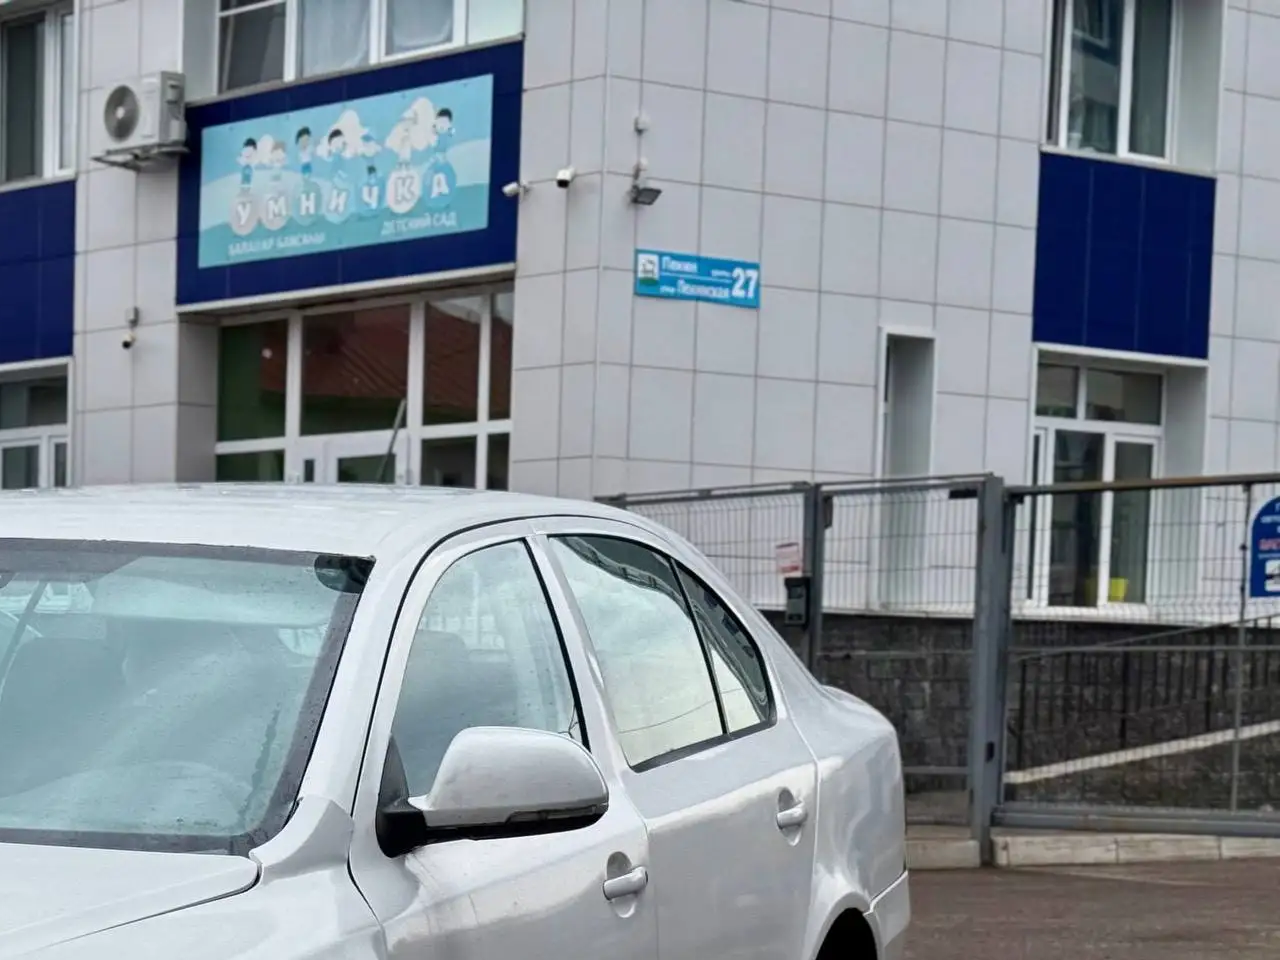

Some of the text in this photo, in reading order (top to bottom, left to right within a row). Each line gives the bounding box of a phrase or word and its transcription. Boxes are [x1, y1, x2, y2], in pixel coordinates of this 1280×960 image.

[236, 172, 449, 225] УМНИЧКА
[433, 210, 458, 228] САД
[731, 267, 758, 299] 27
